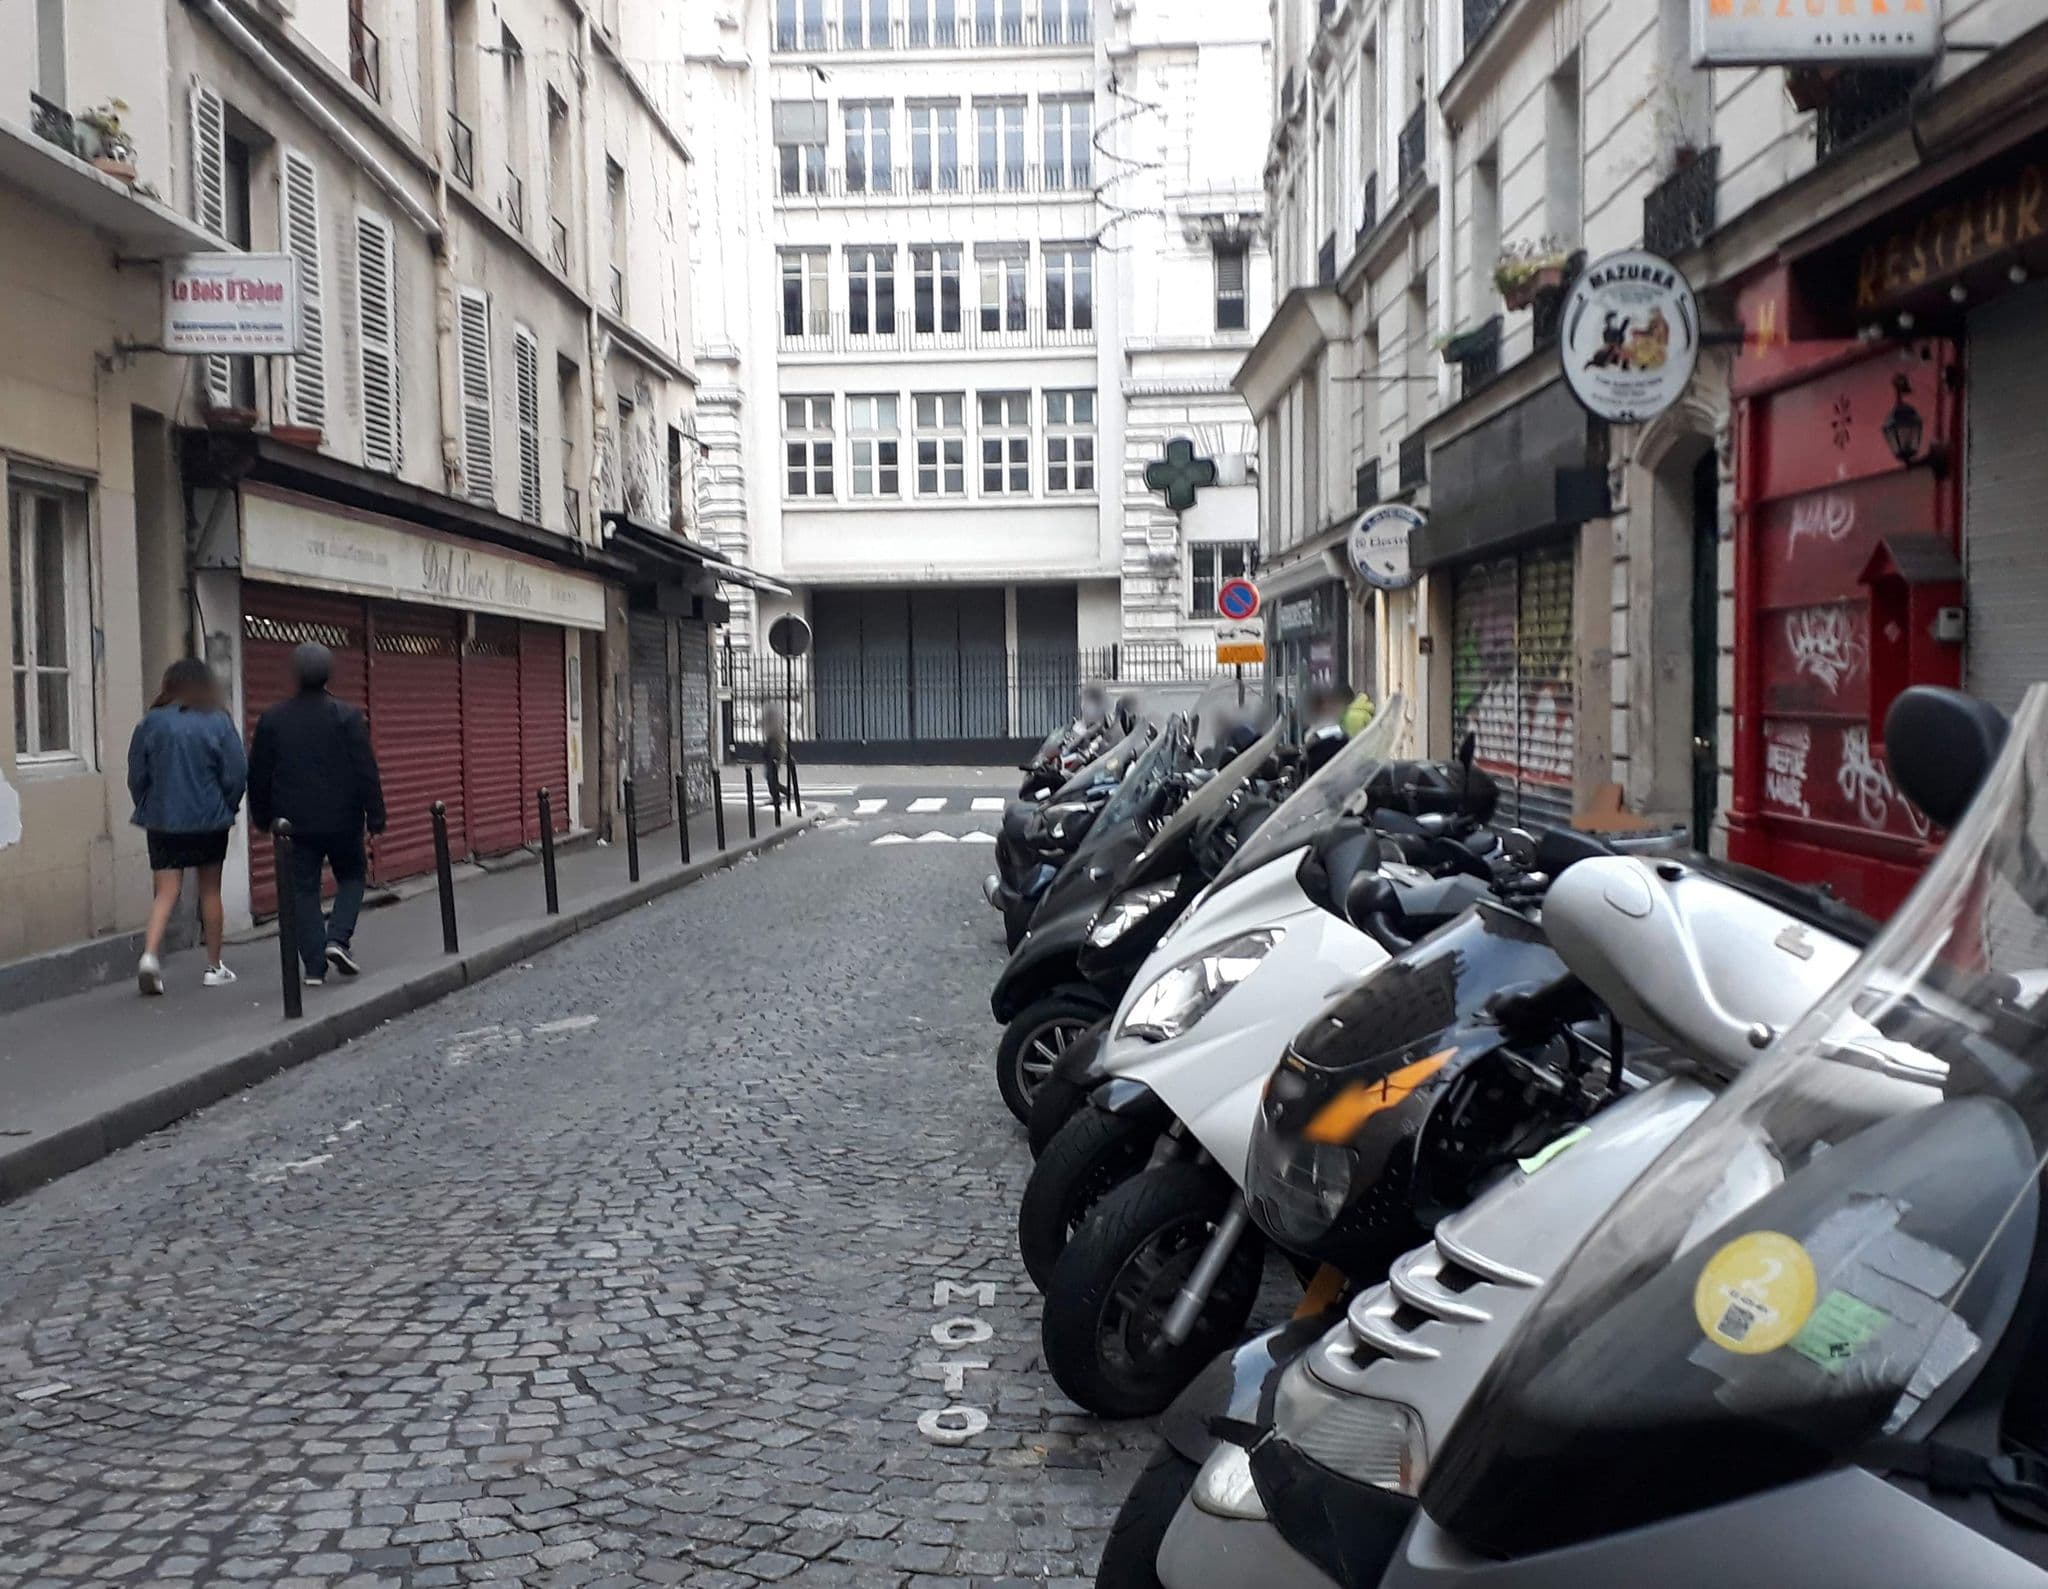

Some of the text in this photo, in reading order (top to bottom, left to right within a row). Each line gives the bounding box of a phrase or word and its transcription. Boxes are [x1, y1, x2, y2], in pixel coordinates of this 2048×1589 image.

[172, 279, 188, 301] Le
[190, 279, 223, 301] Bois
[1589, 264, 1676, 290] MAZURKA
[916, 1280, 997, 1446] MOTO
